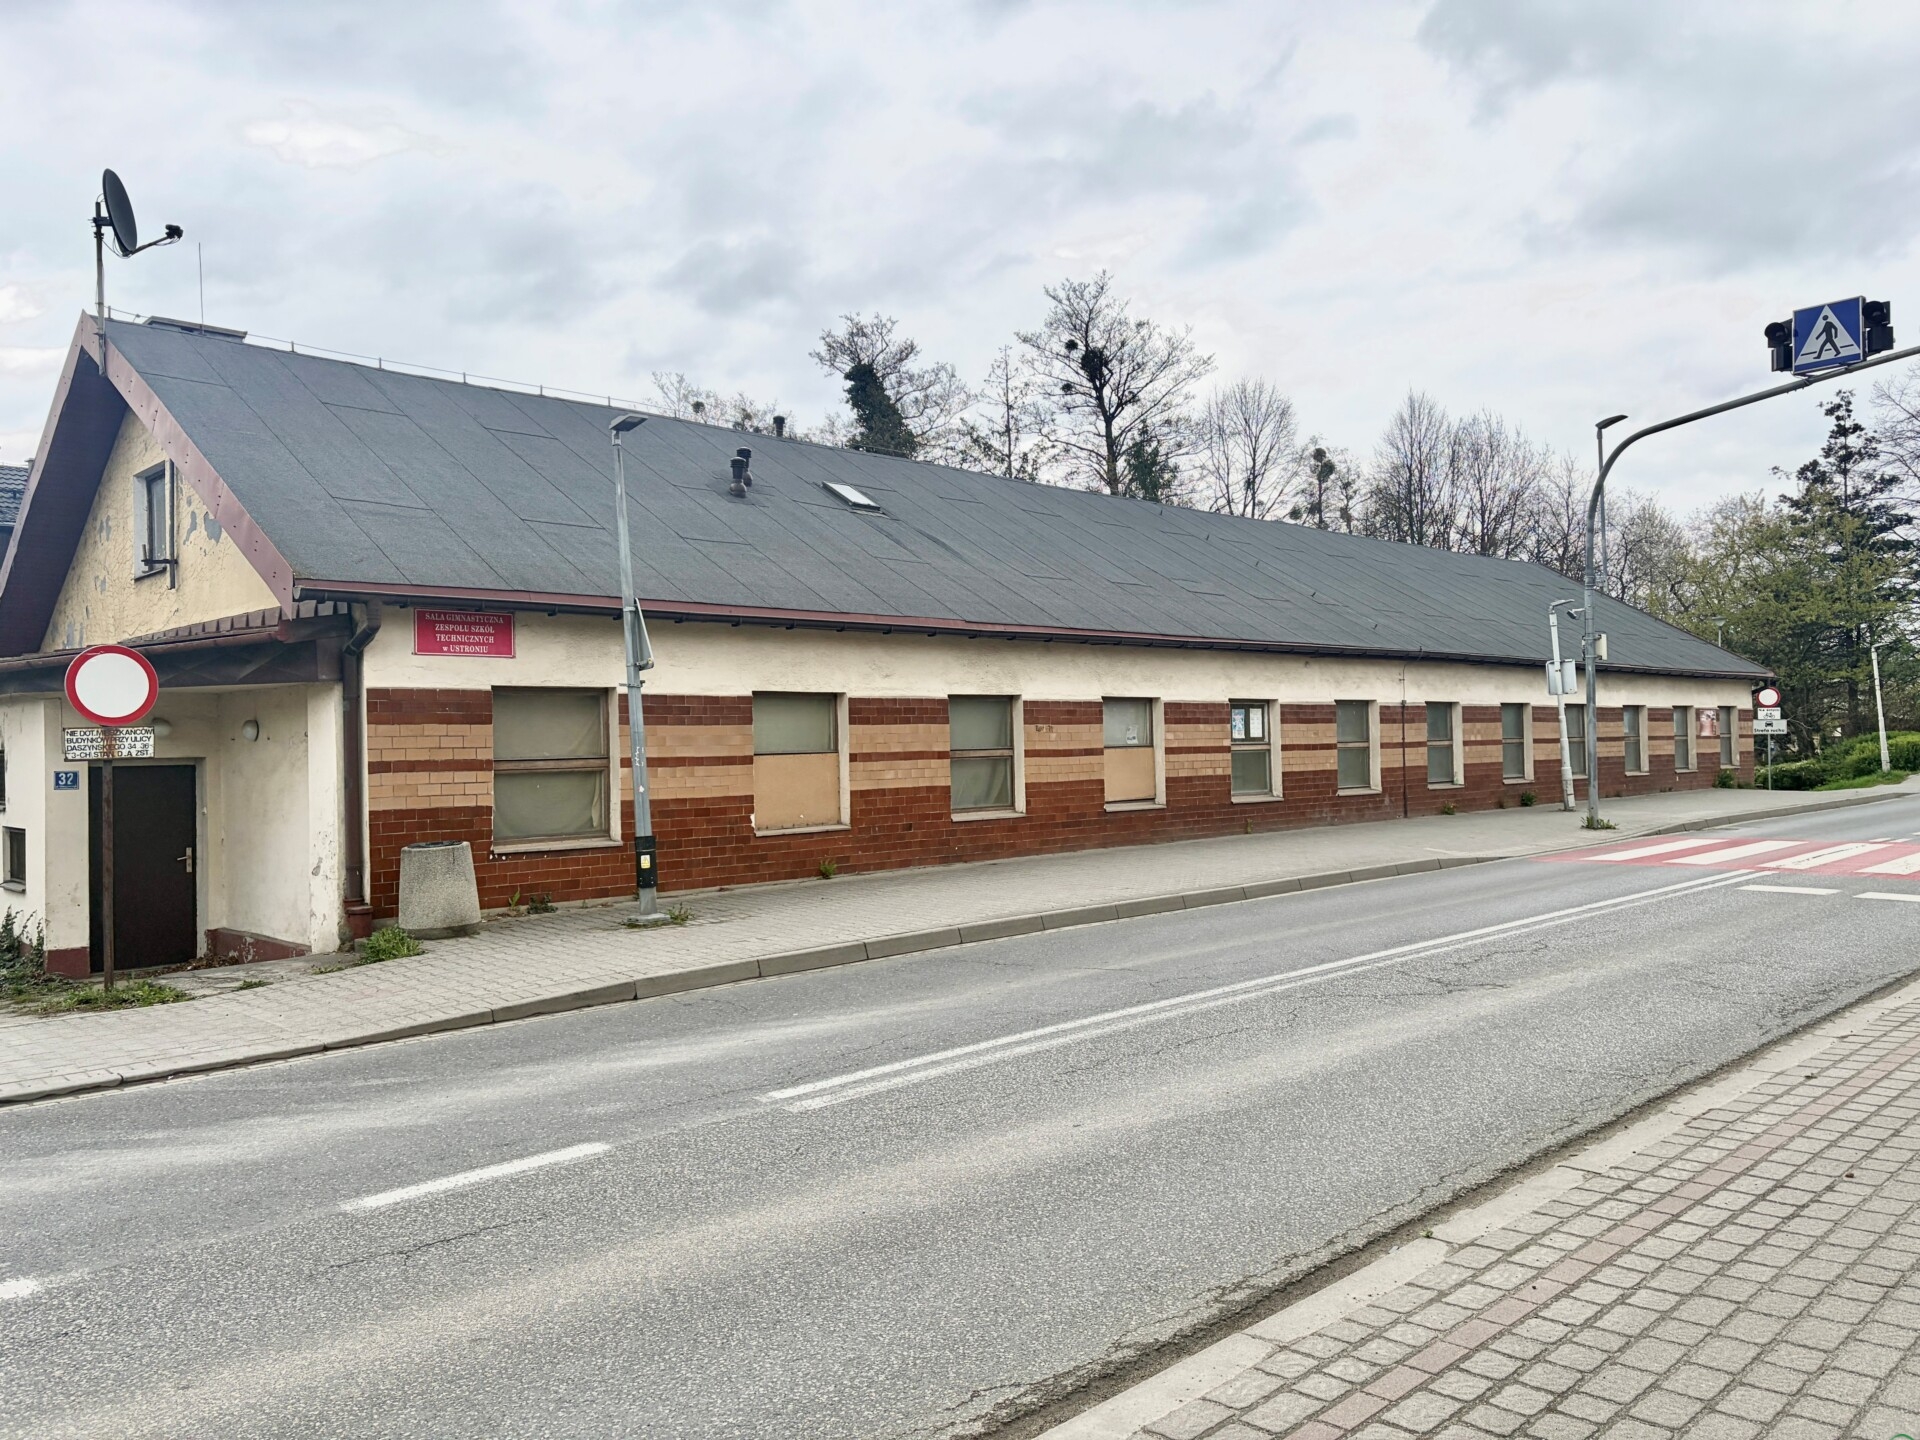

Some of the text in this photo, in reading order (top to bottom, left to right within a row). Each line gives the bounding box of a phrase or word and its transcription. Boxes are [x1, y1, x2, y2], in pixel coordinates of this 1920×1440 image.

[446, 614, 504, 623] GIMNASTYCZNA
[435, 624, 495, 633] ZESPOŁU SZKÓŁ
[436, 634, 495, 643] TECHNICZNYCH
[450, 645, 489, 653] USTRONIU
[130, 735, 152, 743] ULICY
[58, 773, 74, 785] 32
